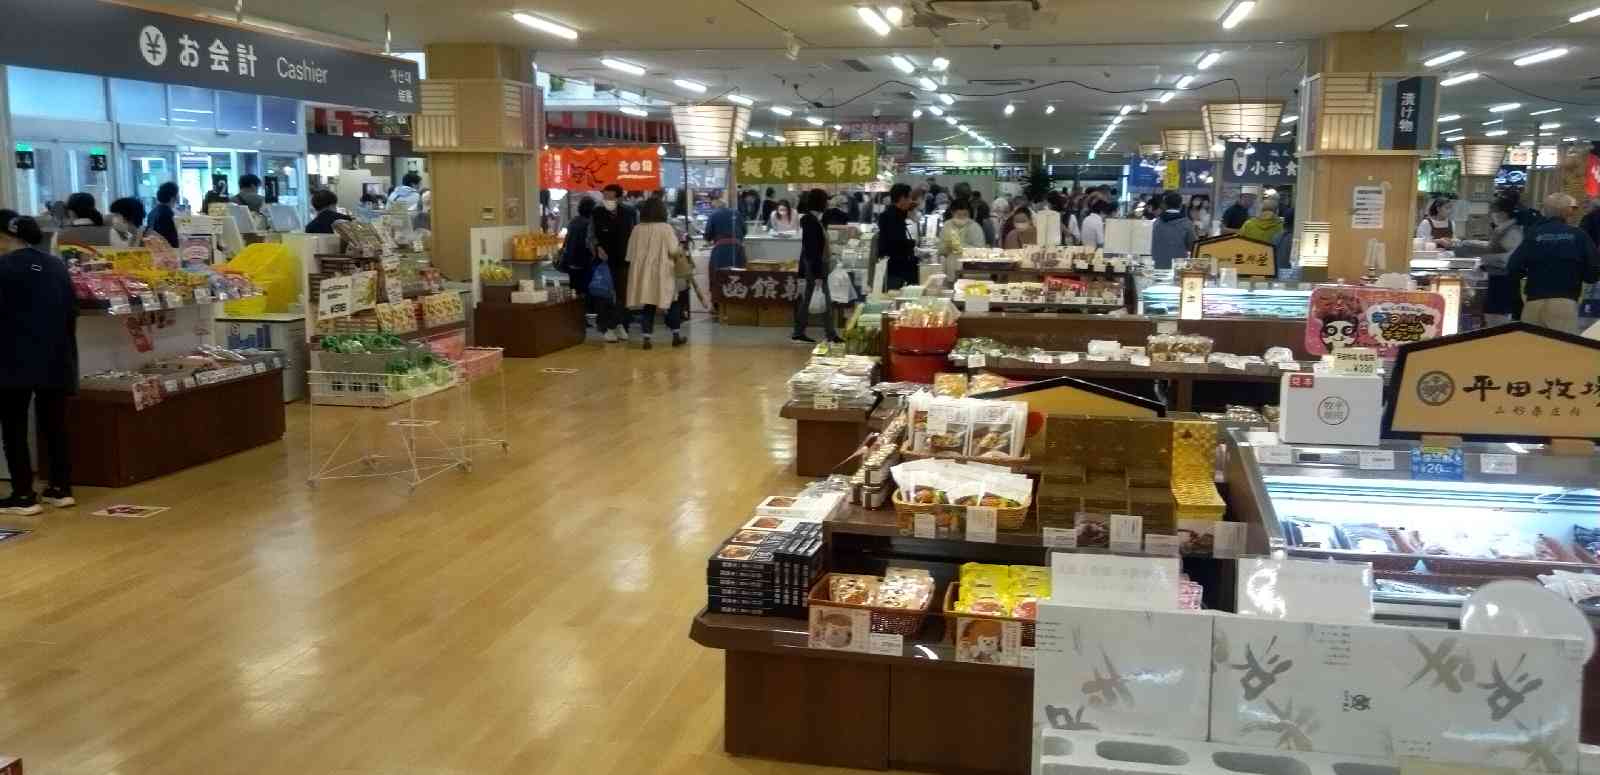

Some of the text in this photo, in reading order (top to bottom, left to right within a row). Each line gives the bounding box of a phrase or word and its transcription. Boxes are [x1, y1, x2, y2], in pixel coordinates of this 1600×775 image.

[179, 34, 257, 78] お会計
[276, 57, 329, 84] Cashier
[1399, 92, 1416, 133] 漬け物
